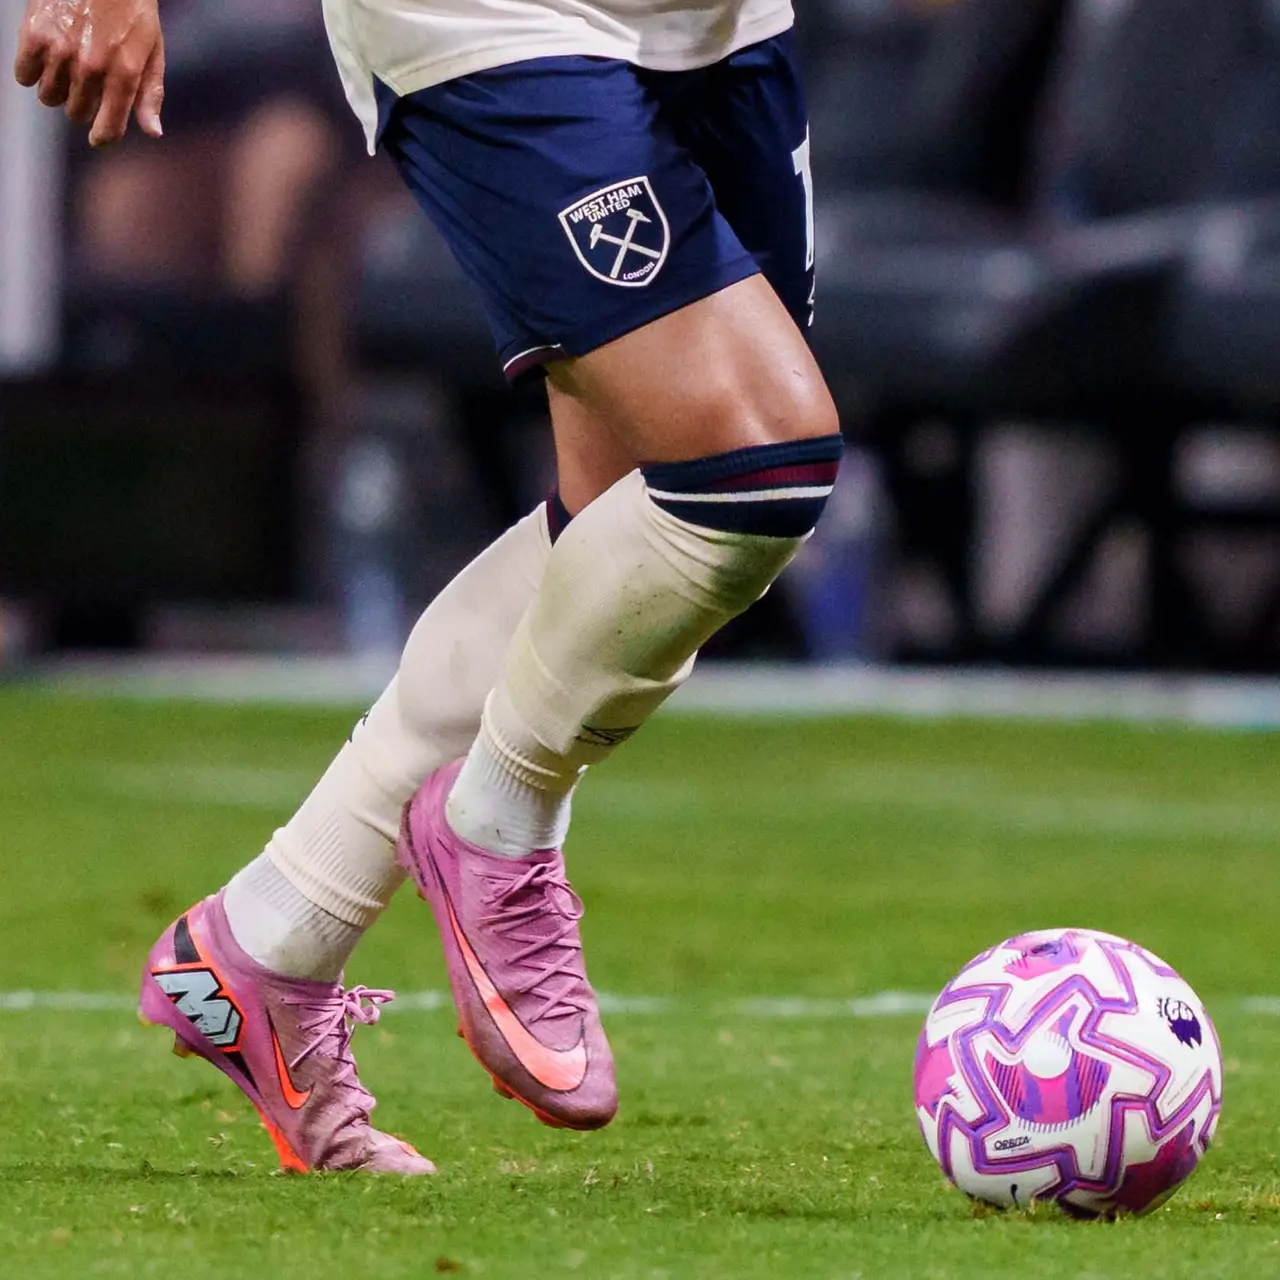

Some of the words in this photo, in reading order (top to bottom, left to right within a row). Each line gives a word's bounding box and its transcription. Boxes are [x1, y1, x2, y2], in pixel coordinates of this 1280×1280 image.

[569, 196, 605, 224] WEST
[607, 184, 643, 205] HAM
[587, 199, 631, 223] UNITED
[623, 261, 655, 280] LONDON
